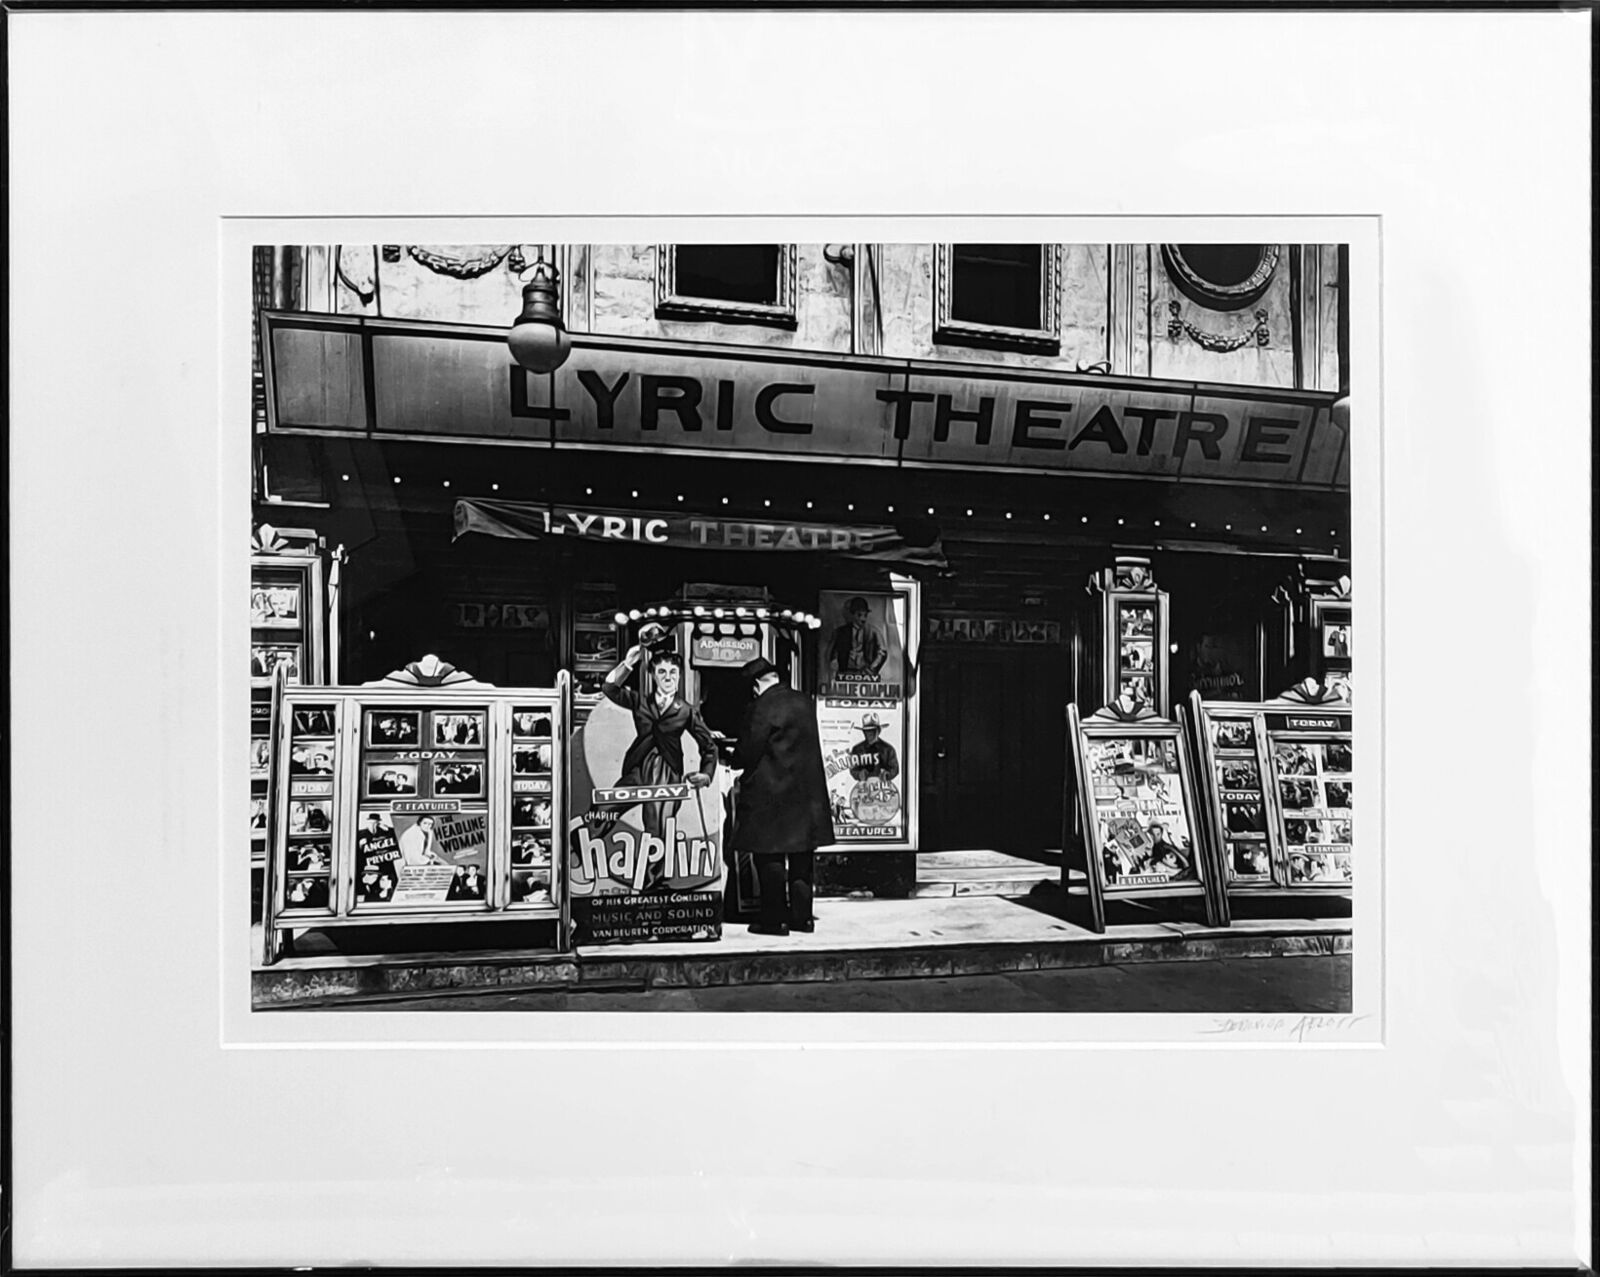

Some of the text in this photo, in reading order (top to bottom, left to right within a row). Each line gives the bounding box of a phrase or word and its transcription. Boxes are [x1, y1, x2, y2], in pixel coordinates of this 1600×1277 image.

[510, 364, 1301, 464] LYRIC THEATRE
[543, 511, 873, 551] LYRIC THEATRE
[700, 640, 753, 650] ADMISSION
[838, 673, 879, 682] TODAY
[859, 683, 901, 699] CHAPLIN
[1290, 719, 1335, 728] TODAY
[396, 751, 458, 760] TODAY
[293, 783, 329, 793] TODAY
[514, 780, 548, 791] TODAY
[599, 786, 684, 801] TO-DAY
[1219, 792, 1261, 800] TODAY
[406, 802, 457, 811] FEATURES
[584, 811, 619, 823] CHARLIE
[434, 816, 486, 840] HEADLINE
[839, 827, 894, 836] FEATURES
[363, 838, 396, 853] ANGEL
[440, 831, 486, 853] WOMAN
[366, 850, 401, 866] PRYOR
[592, 899, 602, 907] OF
[623, 895, 668, 905] GREATEST
[592, 907, 714, 923] MUSIC AND SOUND
[592, 924, 715, 938] VAN BEUREN CORPORATION
